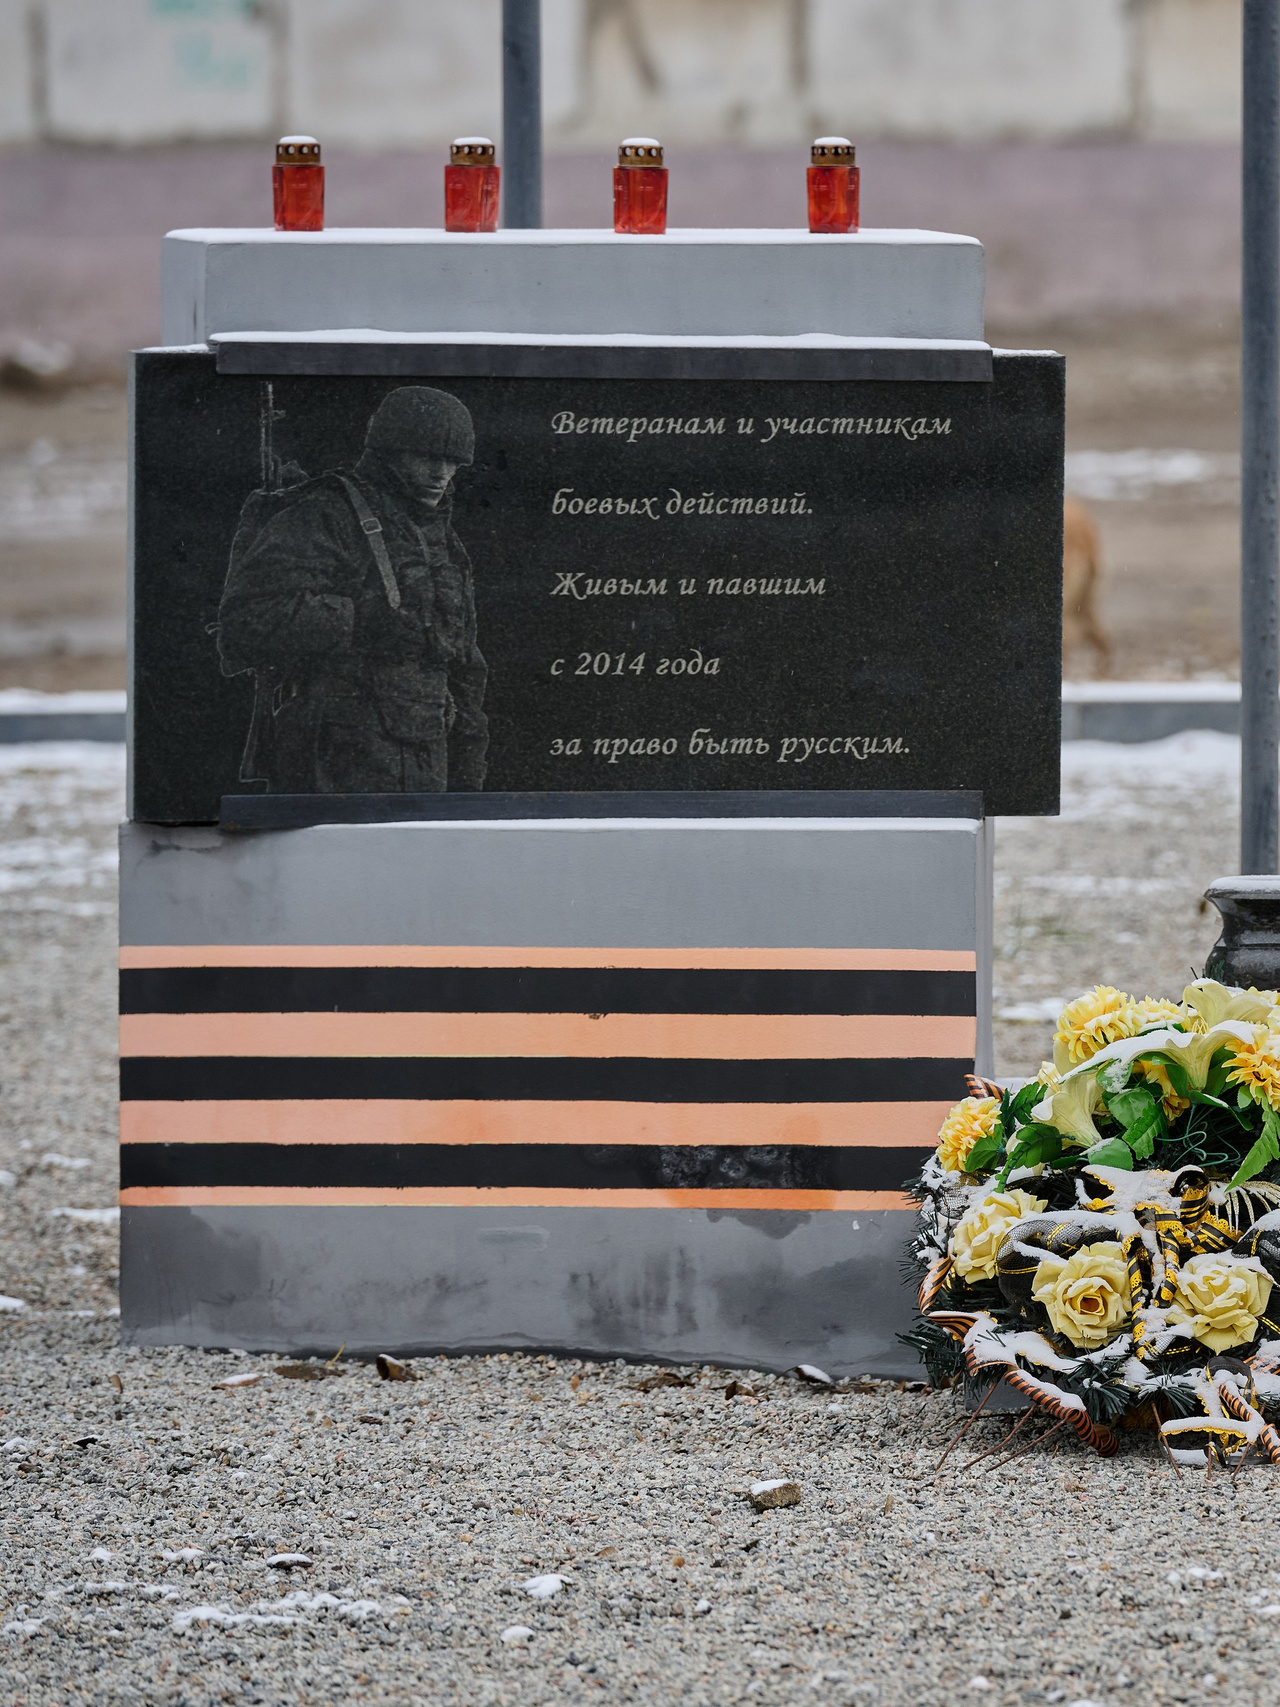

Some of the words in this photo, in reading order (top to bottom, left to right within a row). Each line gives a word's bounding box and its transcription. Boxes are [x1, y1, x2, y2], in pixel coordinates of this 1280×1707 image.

[551, 411, 726, 443] Ветеранам
[737, 417, 754, 435] и
[760, 417, 952, 443] участникам
[551, 488, 660, 520] боевых
[665, 488, 813, 515] действий.
[550, 572, 668, 601] Живым
[678, 578, 697, 595] и
[707, 577, 826, 595] павшим
[550, 658, 565, 676] с
[574, 652, 646, 676] 2014
[655, 648, 720, 676] года
[549, 738, 582, 756] за
[593, 737, 678, 764] право
[688, 727, 770, 755] быть
[776, 736, 910, 763] русским.
